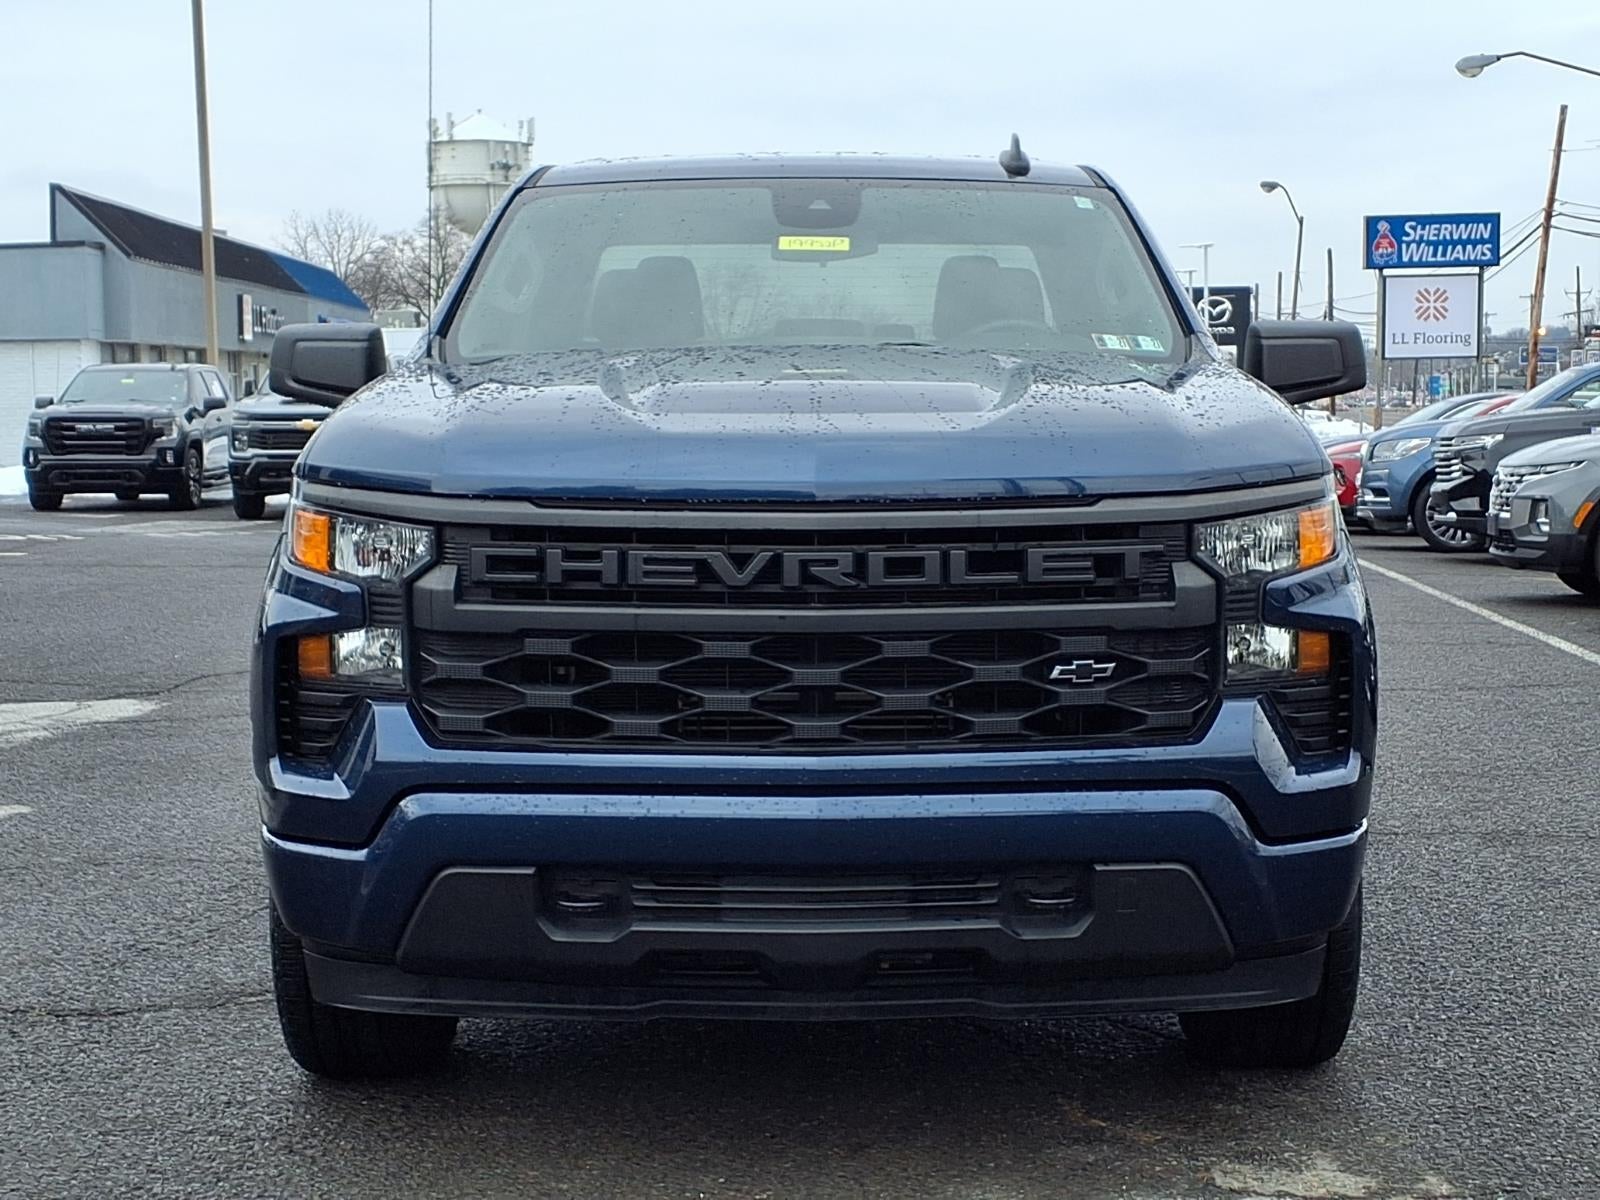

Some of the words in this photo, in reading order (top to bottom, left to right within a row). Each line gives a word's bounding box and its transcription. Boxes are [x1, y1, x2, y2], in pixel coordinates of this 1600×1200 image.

[1402, 221, 1492, 241] SHERWIN
[1401, 243, 1493, 262] WILLIAMS
[1392, 332, 1409, 344] LL
[1413, 331, 1472, 347] Flooring
[469, 545, 1165, 589] CHEVROLET
